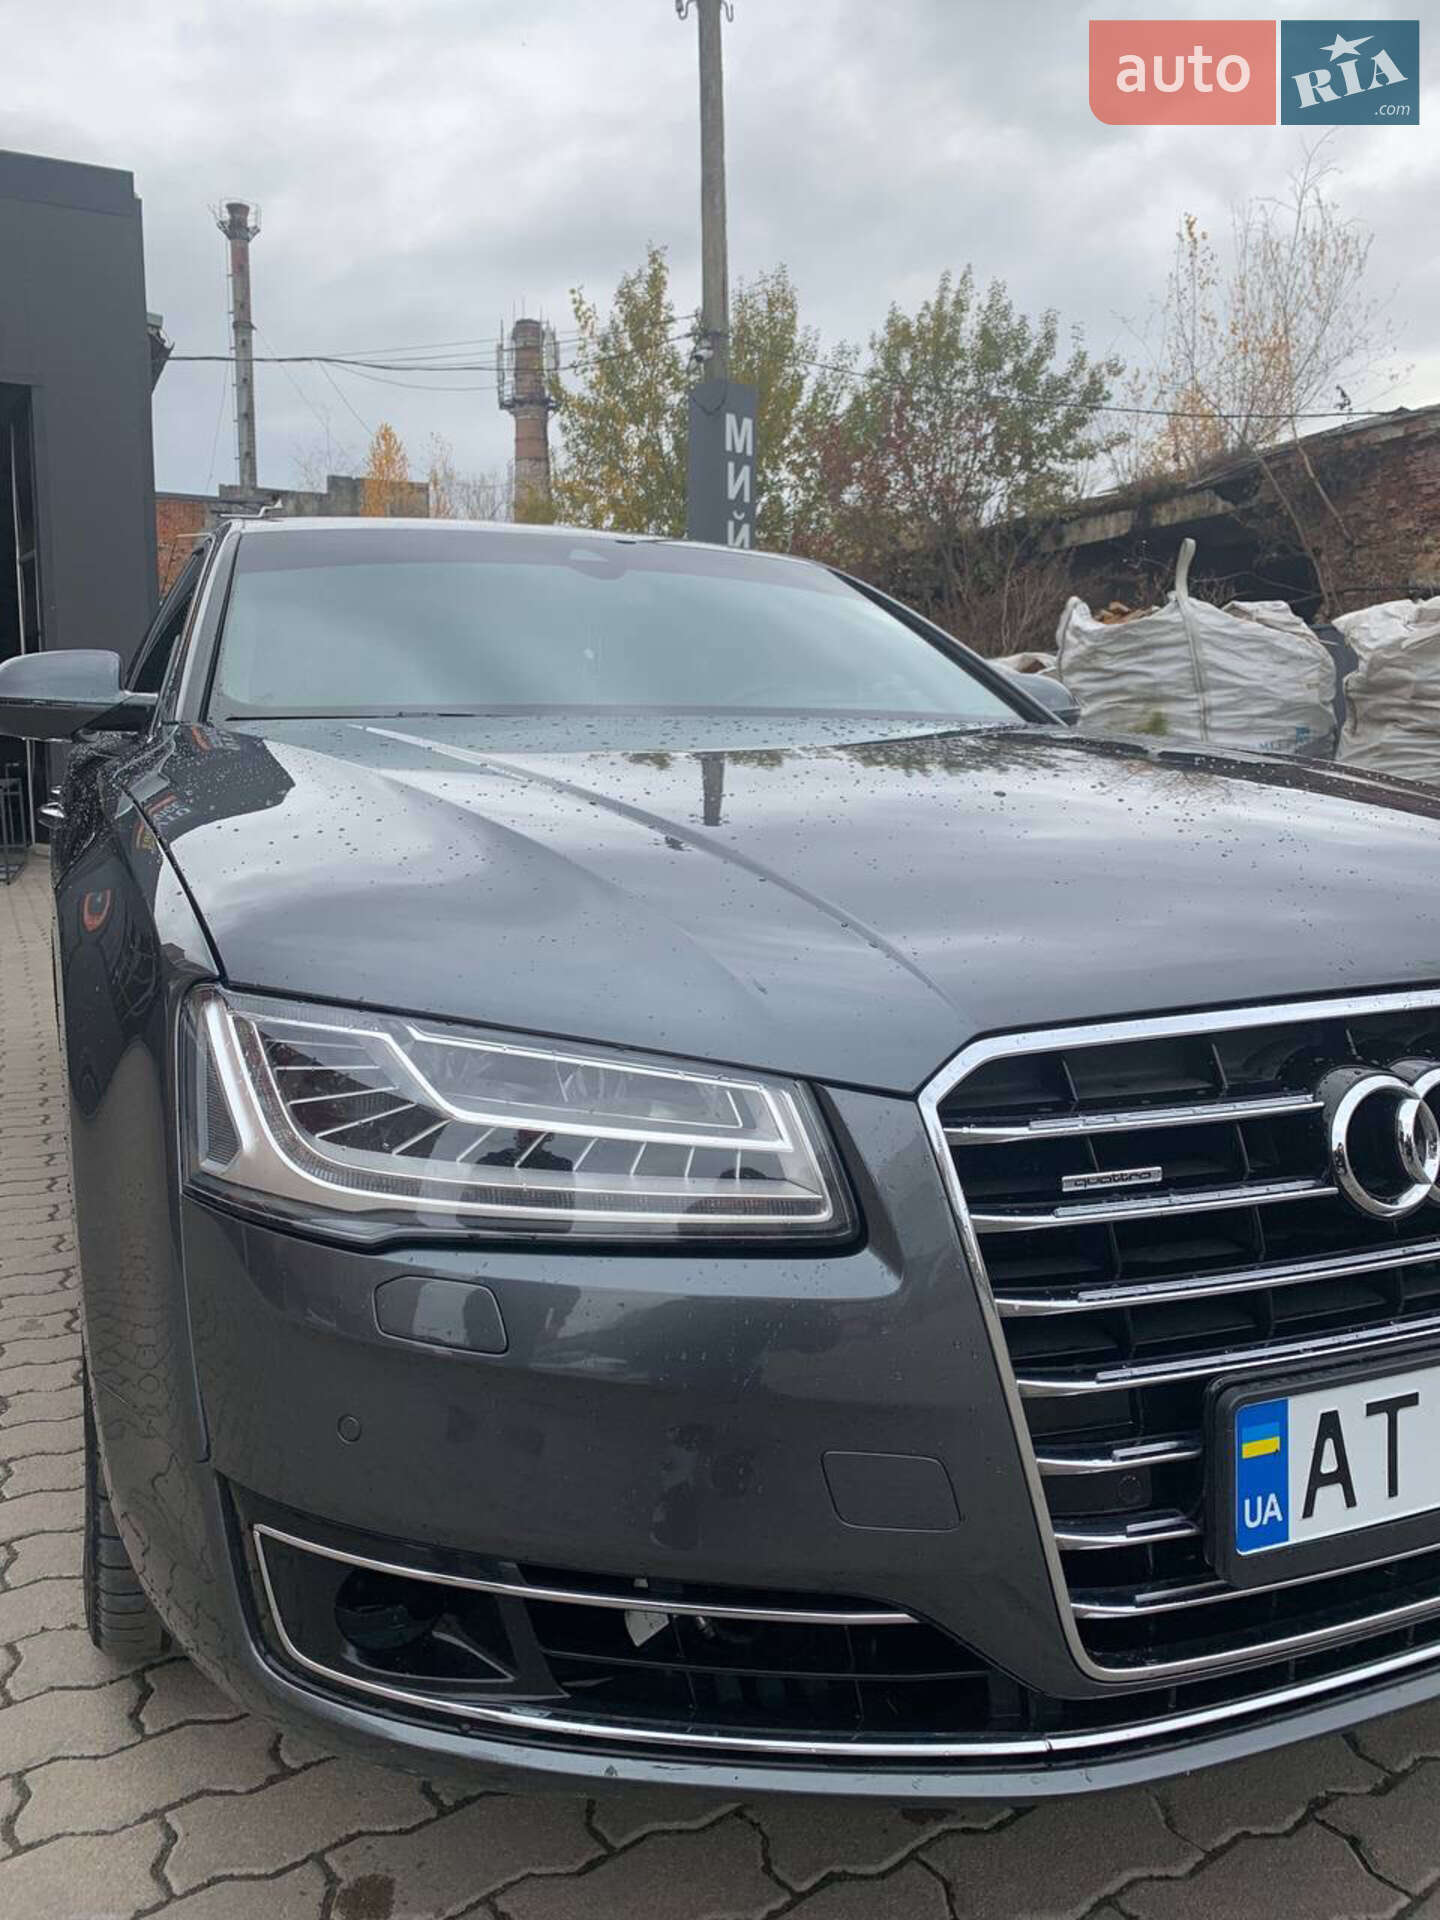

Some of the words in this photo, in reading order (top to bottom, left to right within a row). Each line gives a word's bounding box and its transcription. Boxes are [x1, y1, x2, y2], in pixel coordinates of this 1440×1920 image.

[1074, 1171, 1151, 1188] quattro
[1302, 1391, 1419, 1519] AT
[1244, 1493, 1283, 1528] UA
